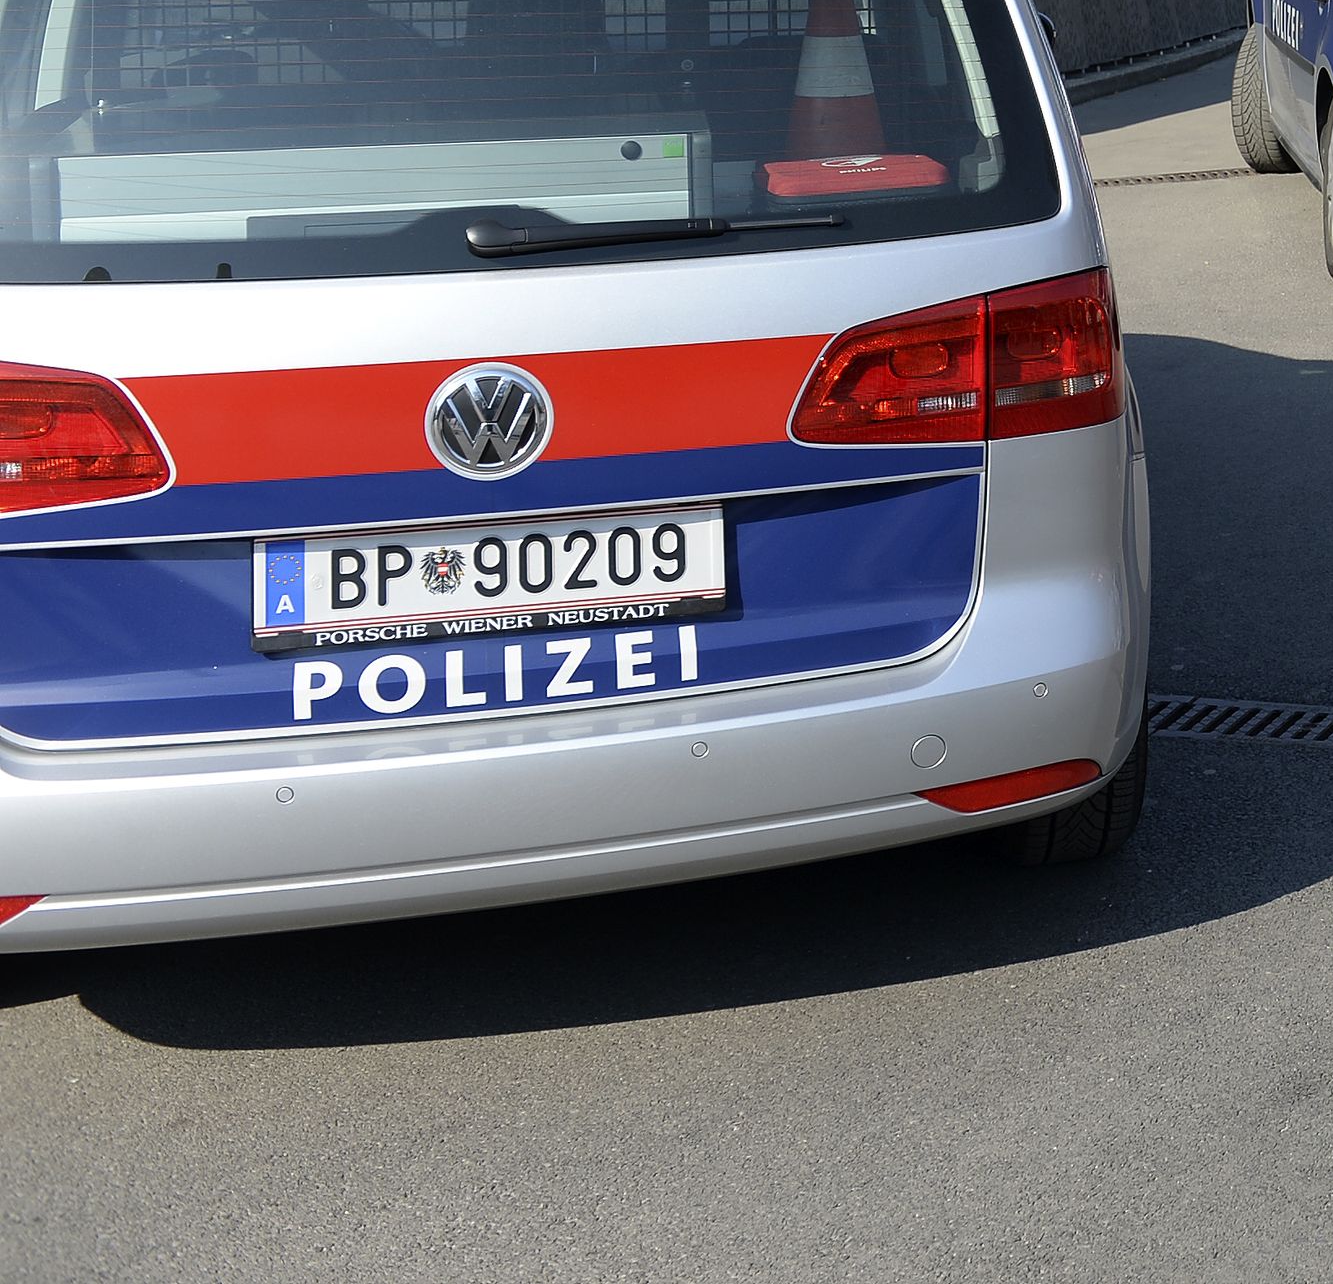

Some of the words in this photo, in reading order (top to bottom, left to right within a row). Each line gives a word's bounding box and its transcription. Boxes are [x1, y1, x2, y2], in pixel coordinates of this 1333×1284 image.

[275, 594, 295, 614] A
[331, 544, 413, 610] BP
[473, 522, 688, 598] 90209
[314, 623, 429, 647] PORSCHE
[443, 614, 534, 636] WIENER
[547, 602, 670, 626] NEUSTADT
[291, 625, 700, 722] POLIZEI
